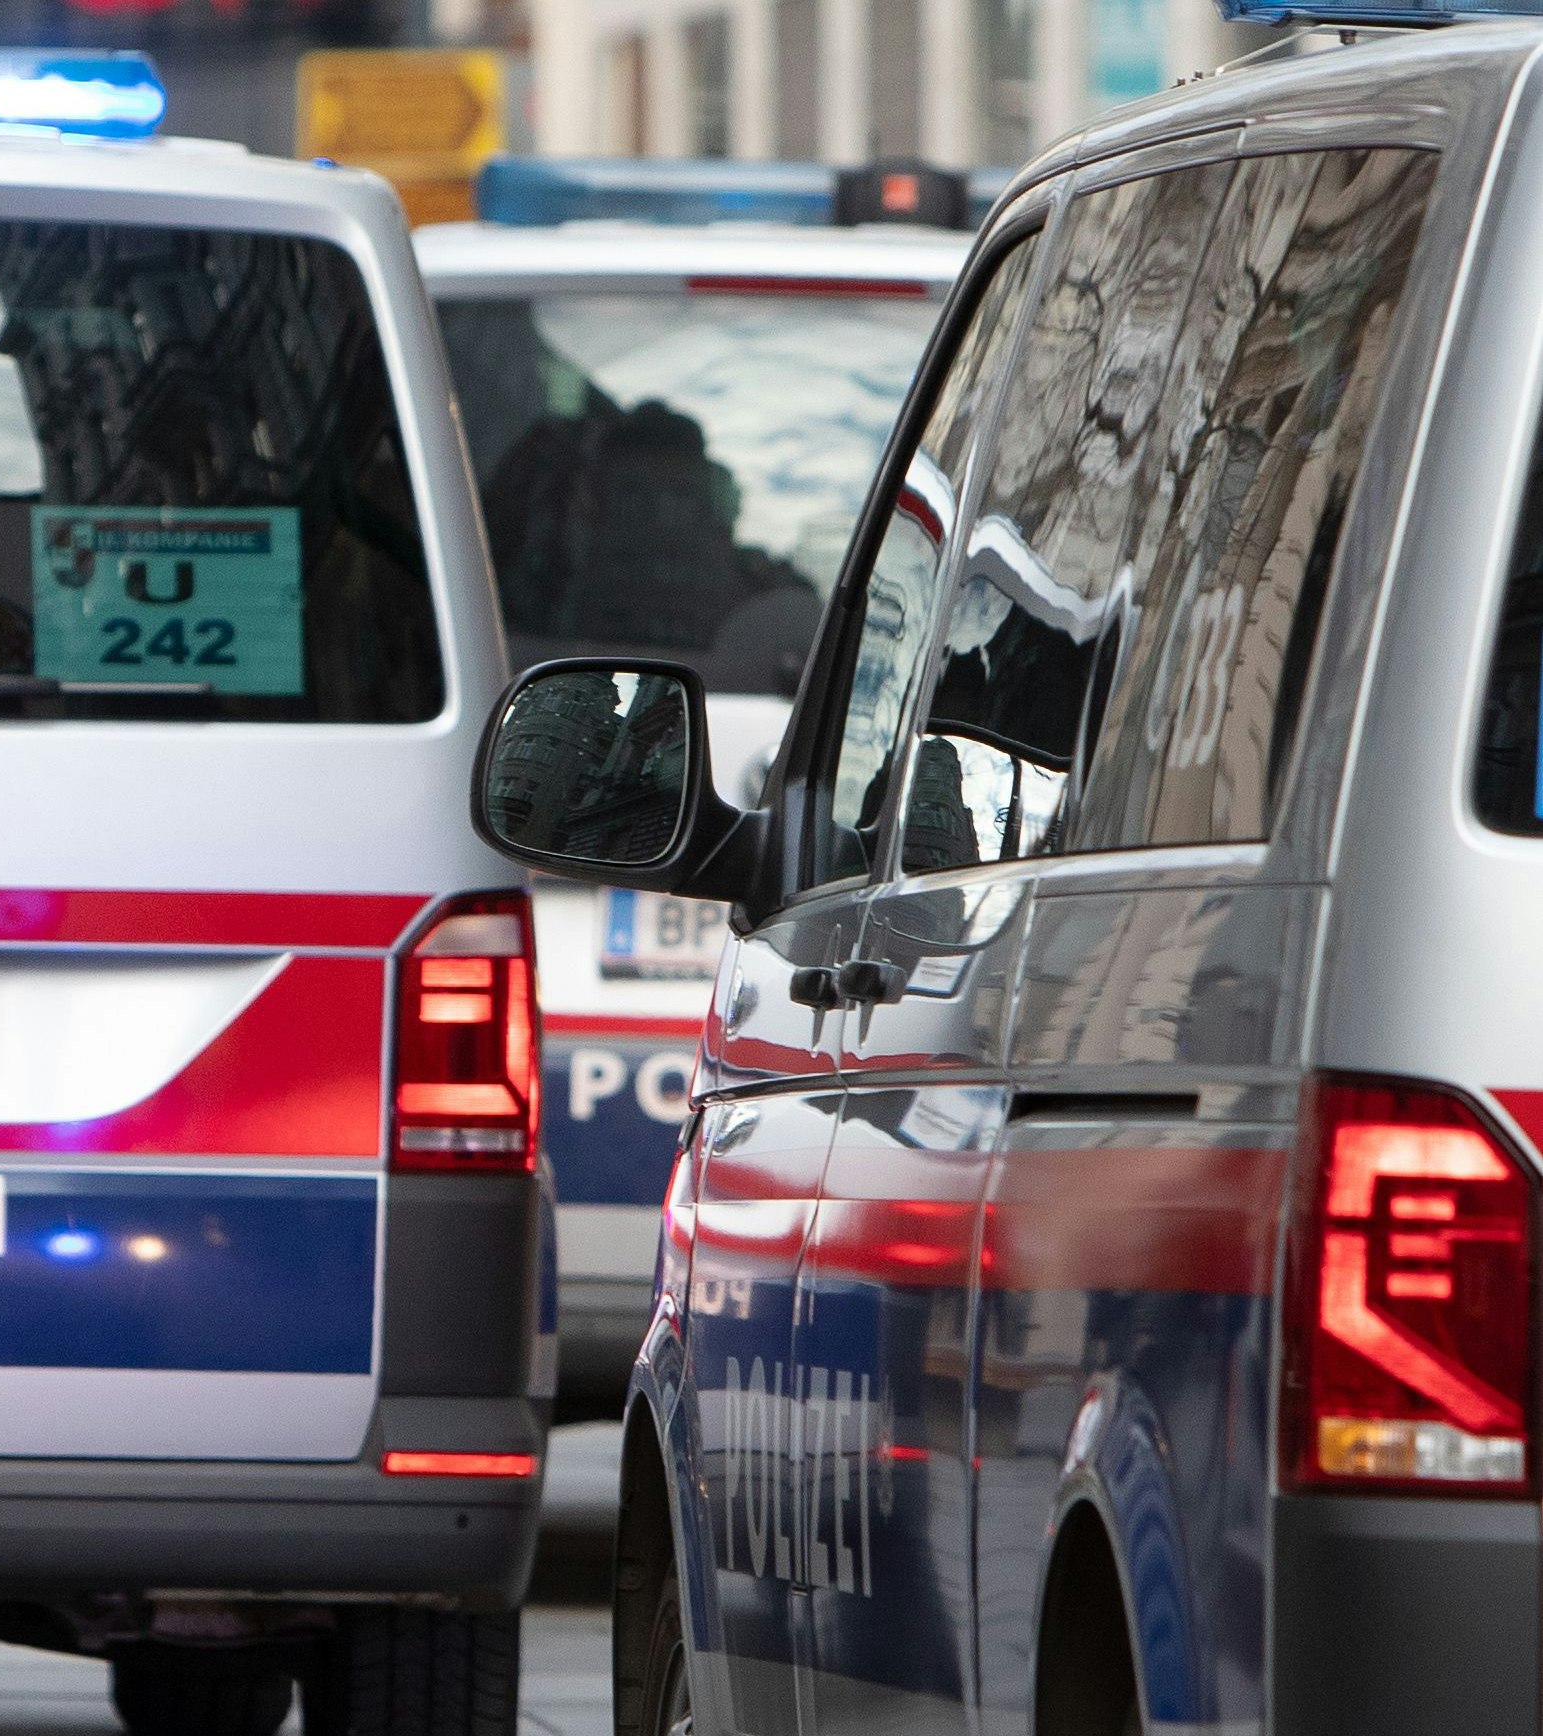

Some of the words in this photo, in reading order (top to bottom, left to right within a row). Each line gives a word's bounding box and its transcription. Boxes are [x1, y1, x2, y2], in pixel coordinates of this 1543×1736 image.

[124, 560, 195, 604] U
[100, 617, 237, 667] 242
[725, 1356, 873, 1598] POLIZEI
